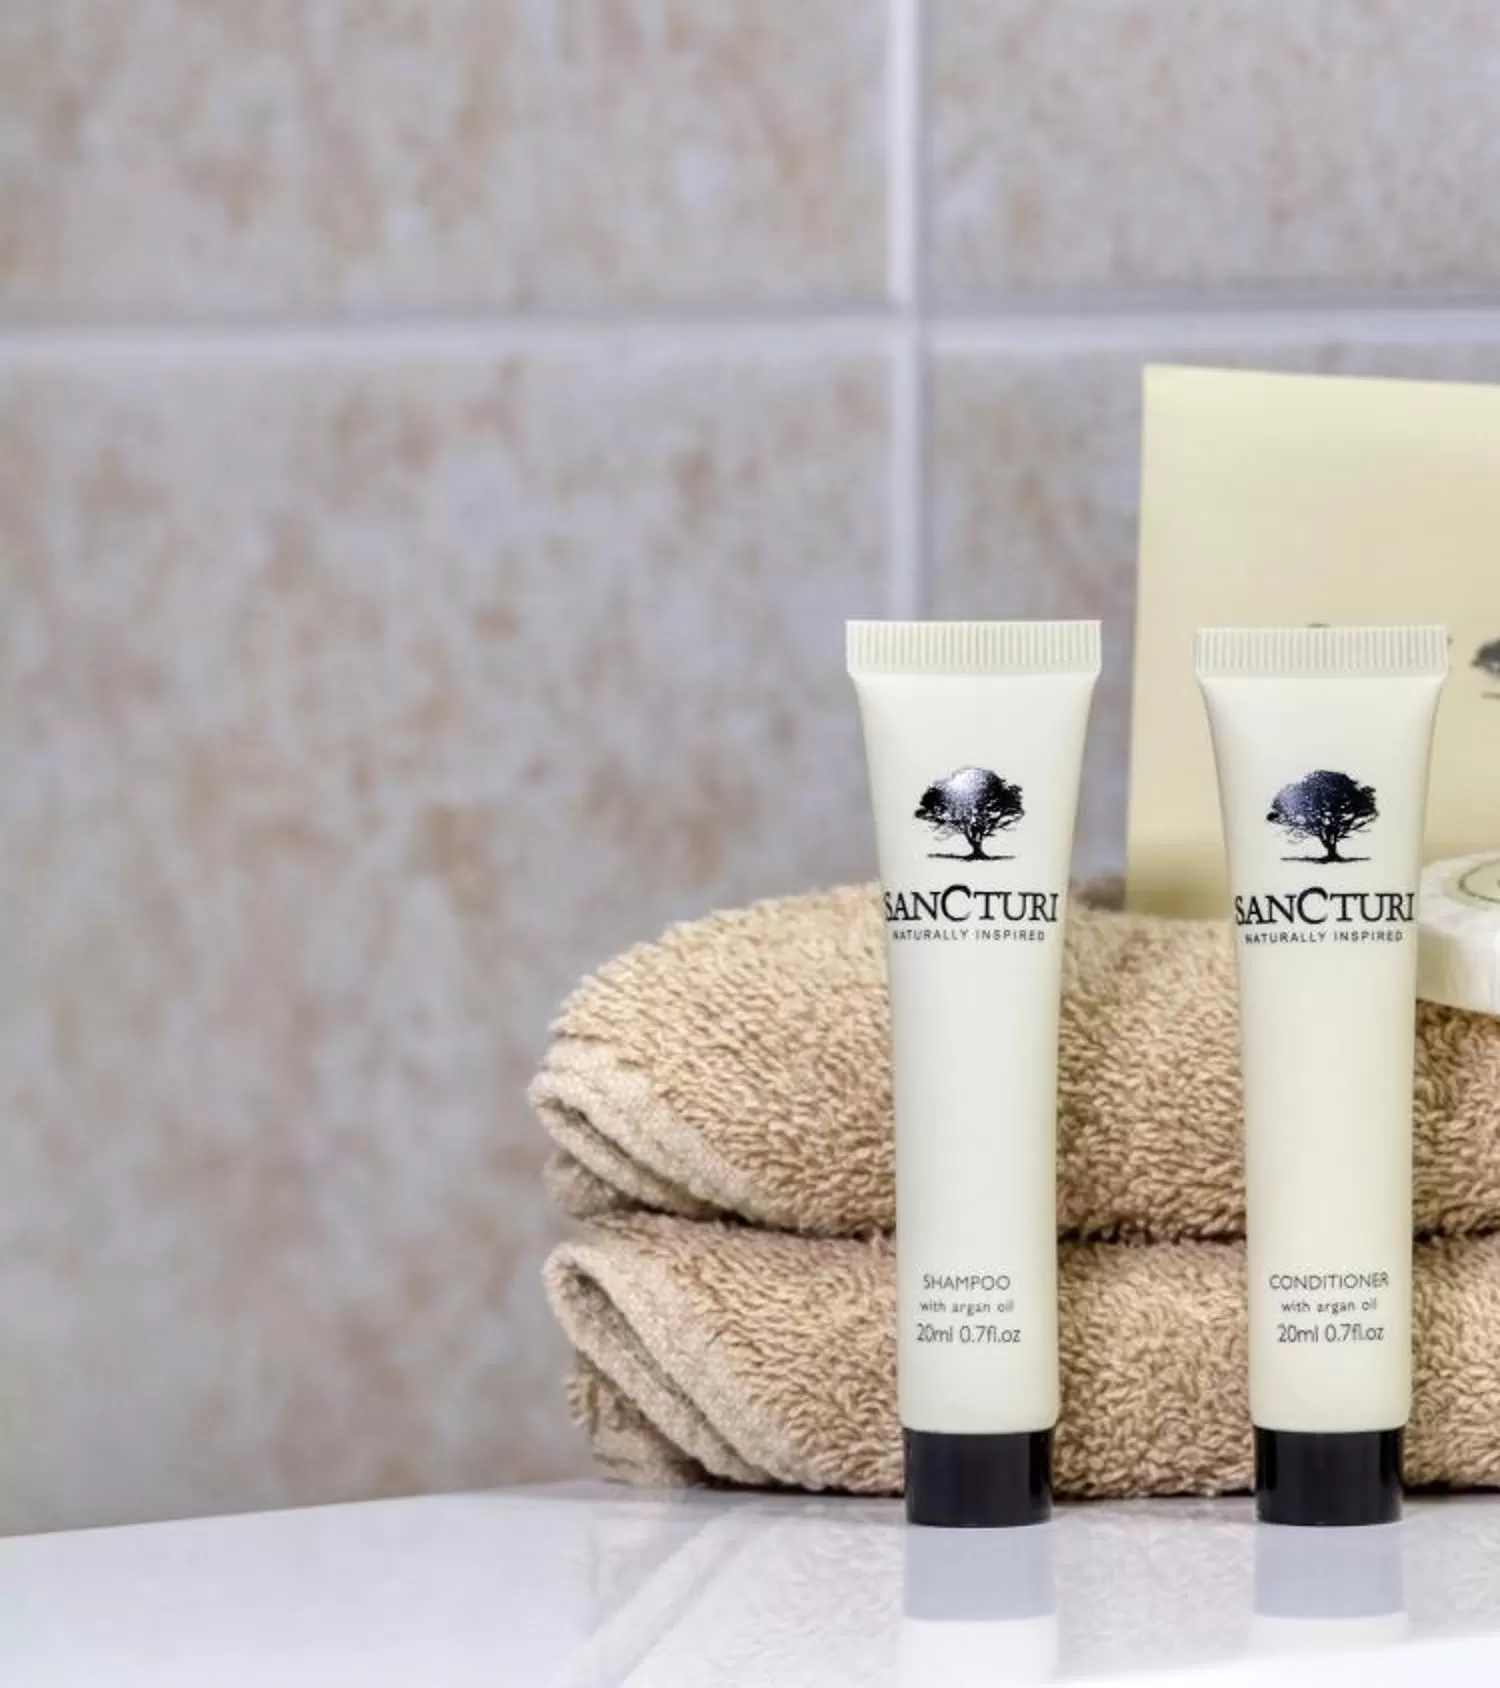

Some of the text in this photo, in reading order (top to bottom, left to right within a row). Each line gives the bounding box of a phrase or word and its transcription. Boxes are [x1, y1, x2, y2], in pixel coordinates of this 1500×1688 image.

[884, 884, 1060, 923] SANCTURI
[1234, 886, 1416, 926] SANCTURI
[893, 929, 1045, 942] NATURALLY INSPIRED
[1245, 930, 1403, 944] NATURALLY INSPIRED
[923, 1273, 1012, 1291] SHAMPOO
[1268, 1271, 1390, 1290] CONDITIONER
[919, 1300, 946, 1312] with
[951, 1303, 991, 1316] argan
[1281, 1298, 1377, 1315] with argan oil
[916, 1323, 954, 1343] 20ml
[1276, 1323, 1319, 1343] 20ml
